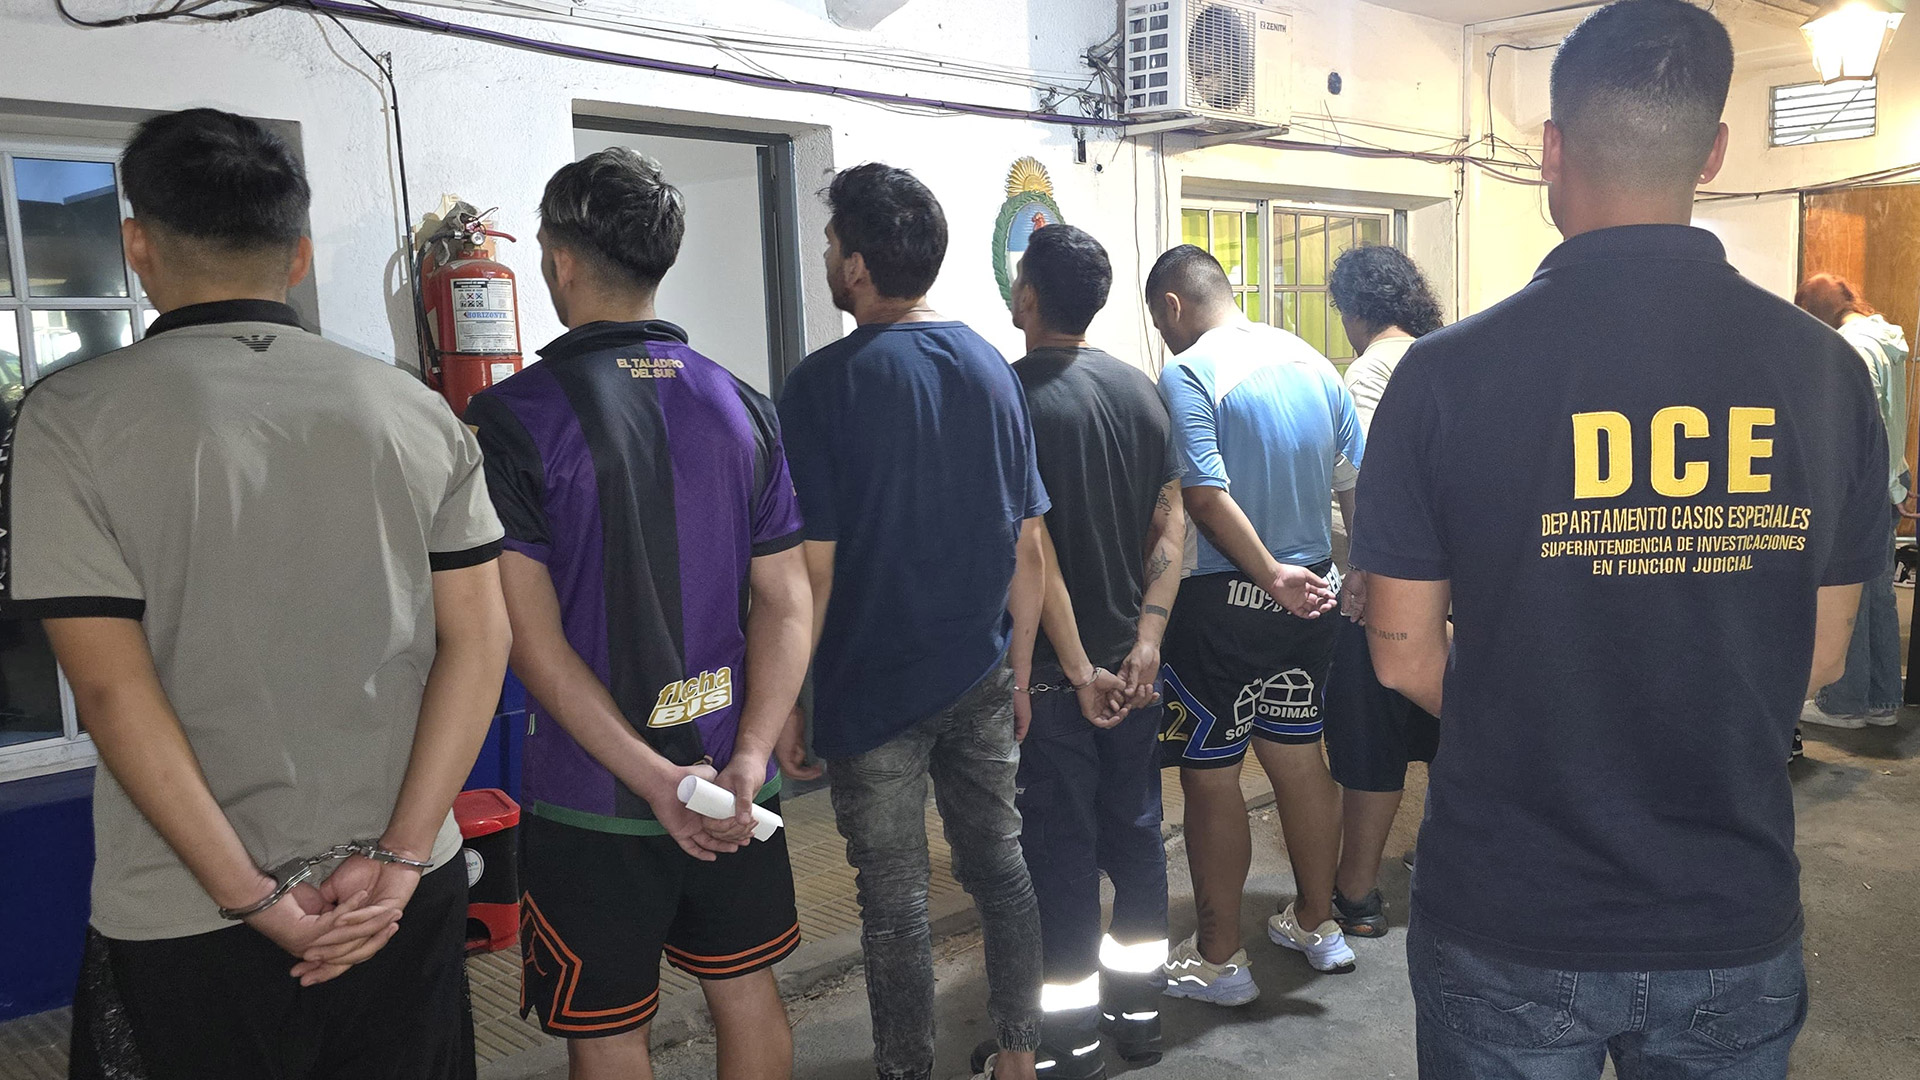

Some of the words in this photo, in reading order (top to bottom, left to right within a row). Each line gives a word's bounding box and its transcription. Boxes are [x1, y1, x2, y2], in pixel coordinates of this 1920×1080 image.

[1266, 22, 1287, 32] ZENITH
[616, 359, 632, 368] EL
[631, 359, 684, 368] TALADRO
[631, 368, 653, 378] DEL
[653, 368, 676, 378] SUR
[1572, 406, 1776, 499] DCE
[1541, 506, 1667, 537] DEPARTAMENTO
[1671, 505, 1724, 530] CASOS
[1728, 504, 1812, 530] ESPECIALES
[1541, 536, 1672, 558] SUPERINTENDENCIA
[1677, 536, 1694, 552] DE
[1592, 559, 1613, 576] EN
[1618, 556, 1686, 576] FUNCION
[1692, 555, 1754, 573] JUDICIAL
[658, 666, 731, 706] ficha
[650, 688, 731, 725] BUS
[1257, 703, 1319, 719] ODIMAC
[1225, 721, 1252, 741] SOD
